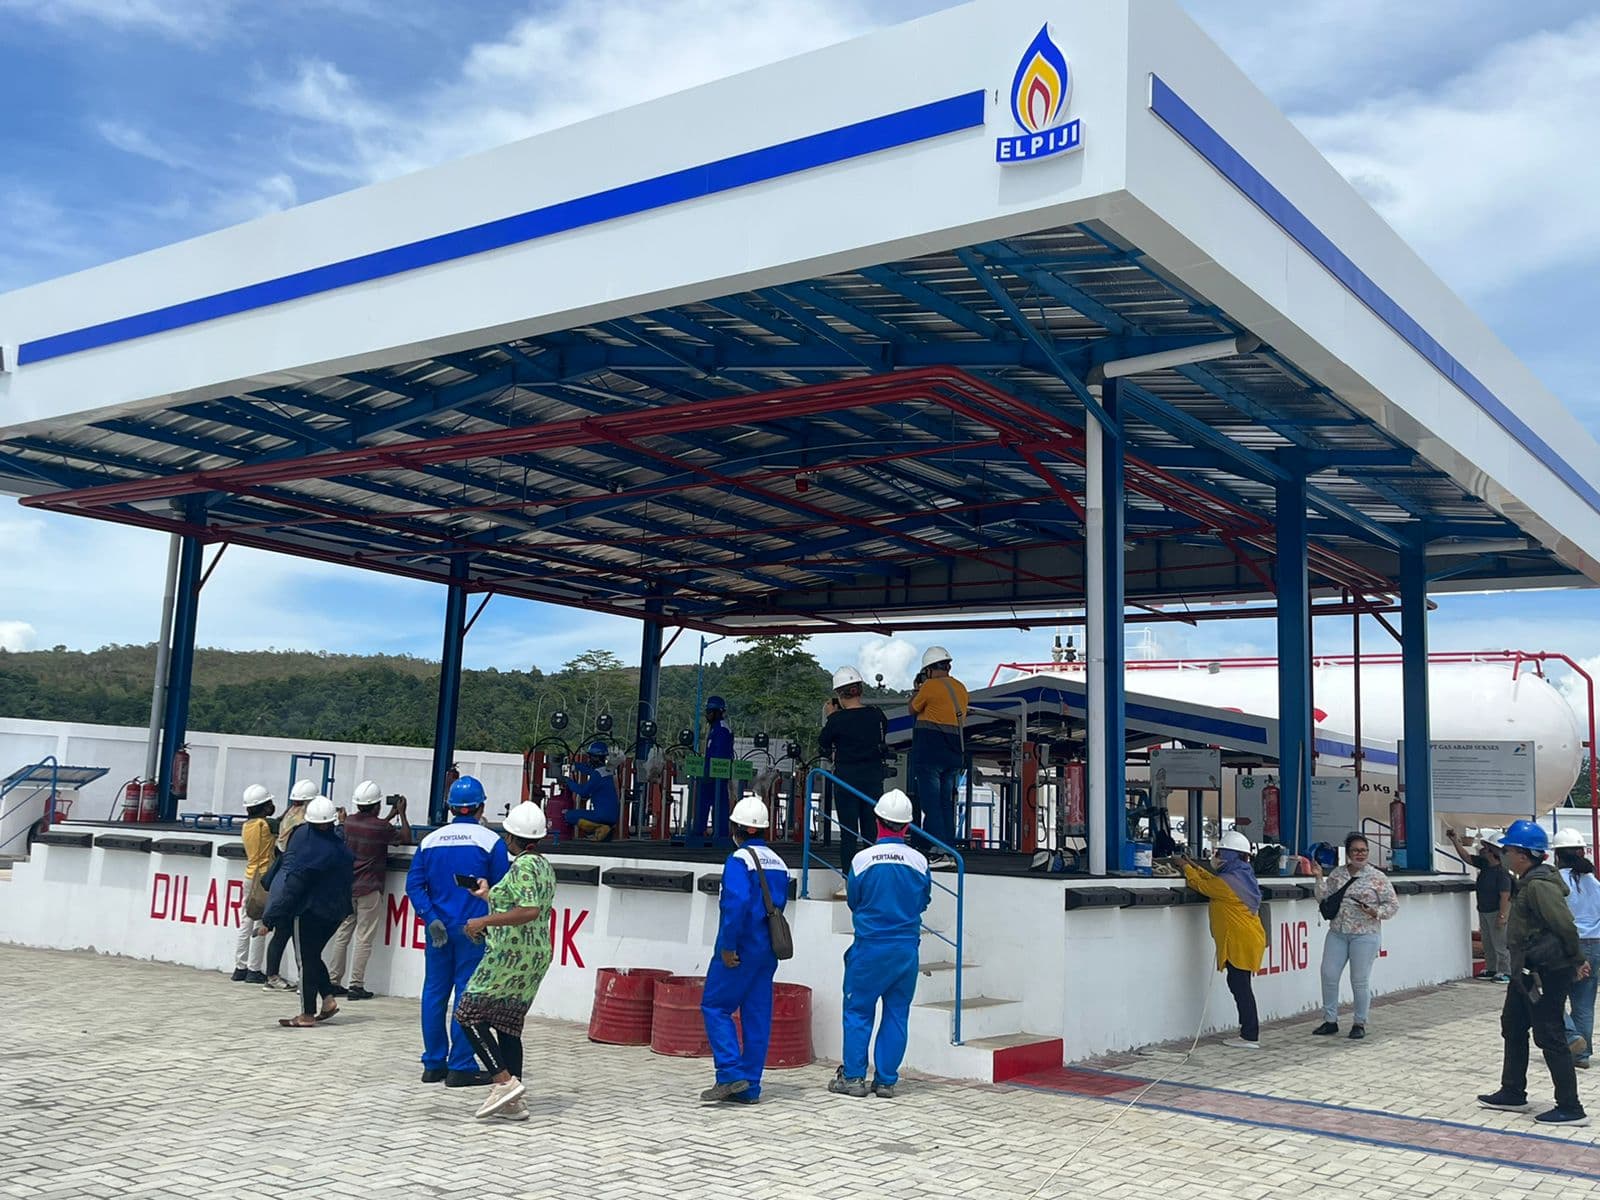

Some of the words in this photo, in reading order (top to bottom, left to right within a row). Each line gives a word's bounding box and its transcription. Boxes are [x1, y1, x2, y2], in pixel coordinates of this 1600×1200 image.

[1000, 124, 1077, 159] ELPIJI
[1373, 784, 1390, 794] Kg
[150, 873, 243, 928] DILAR
